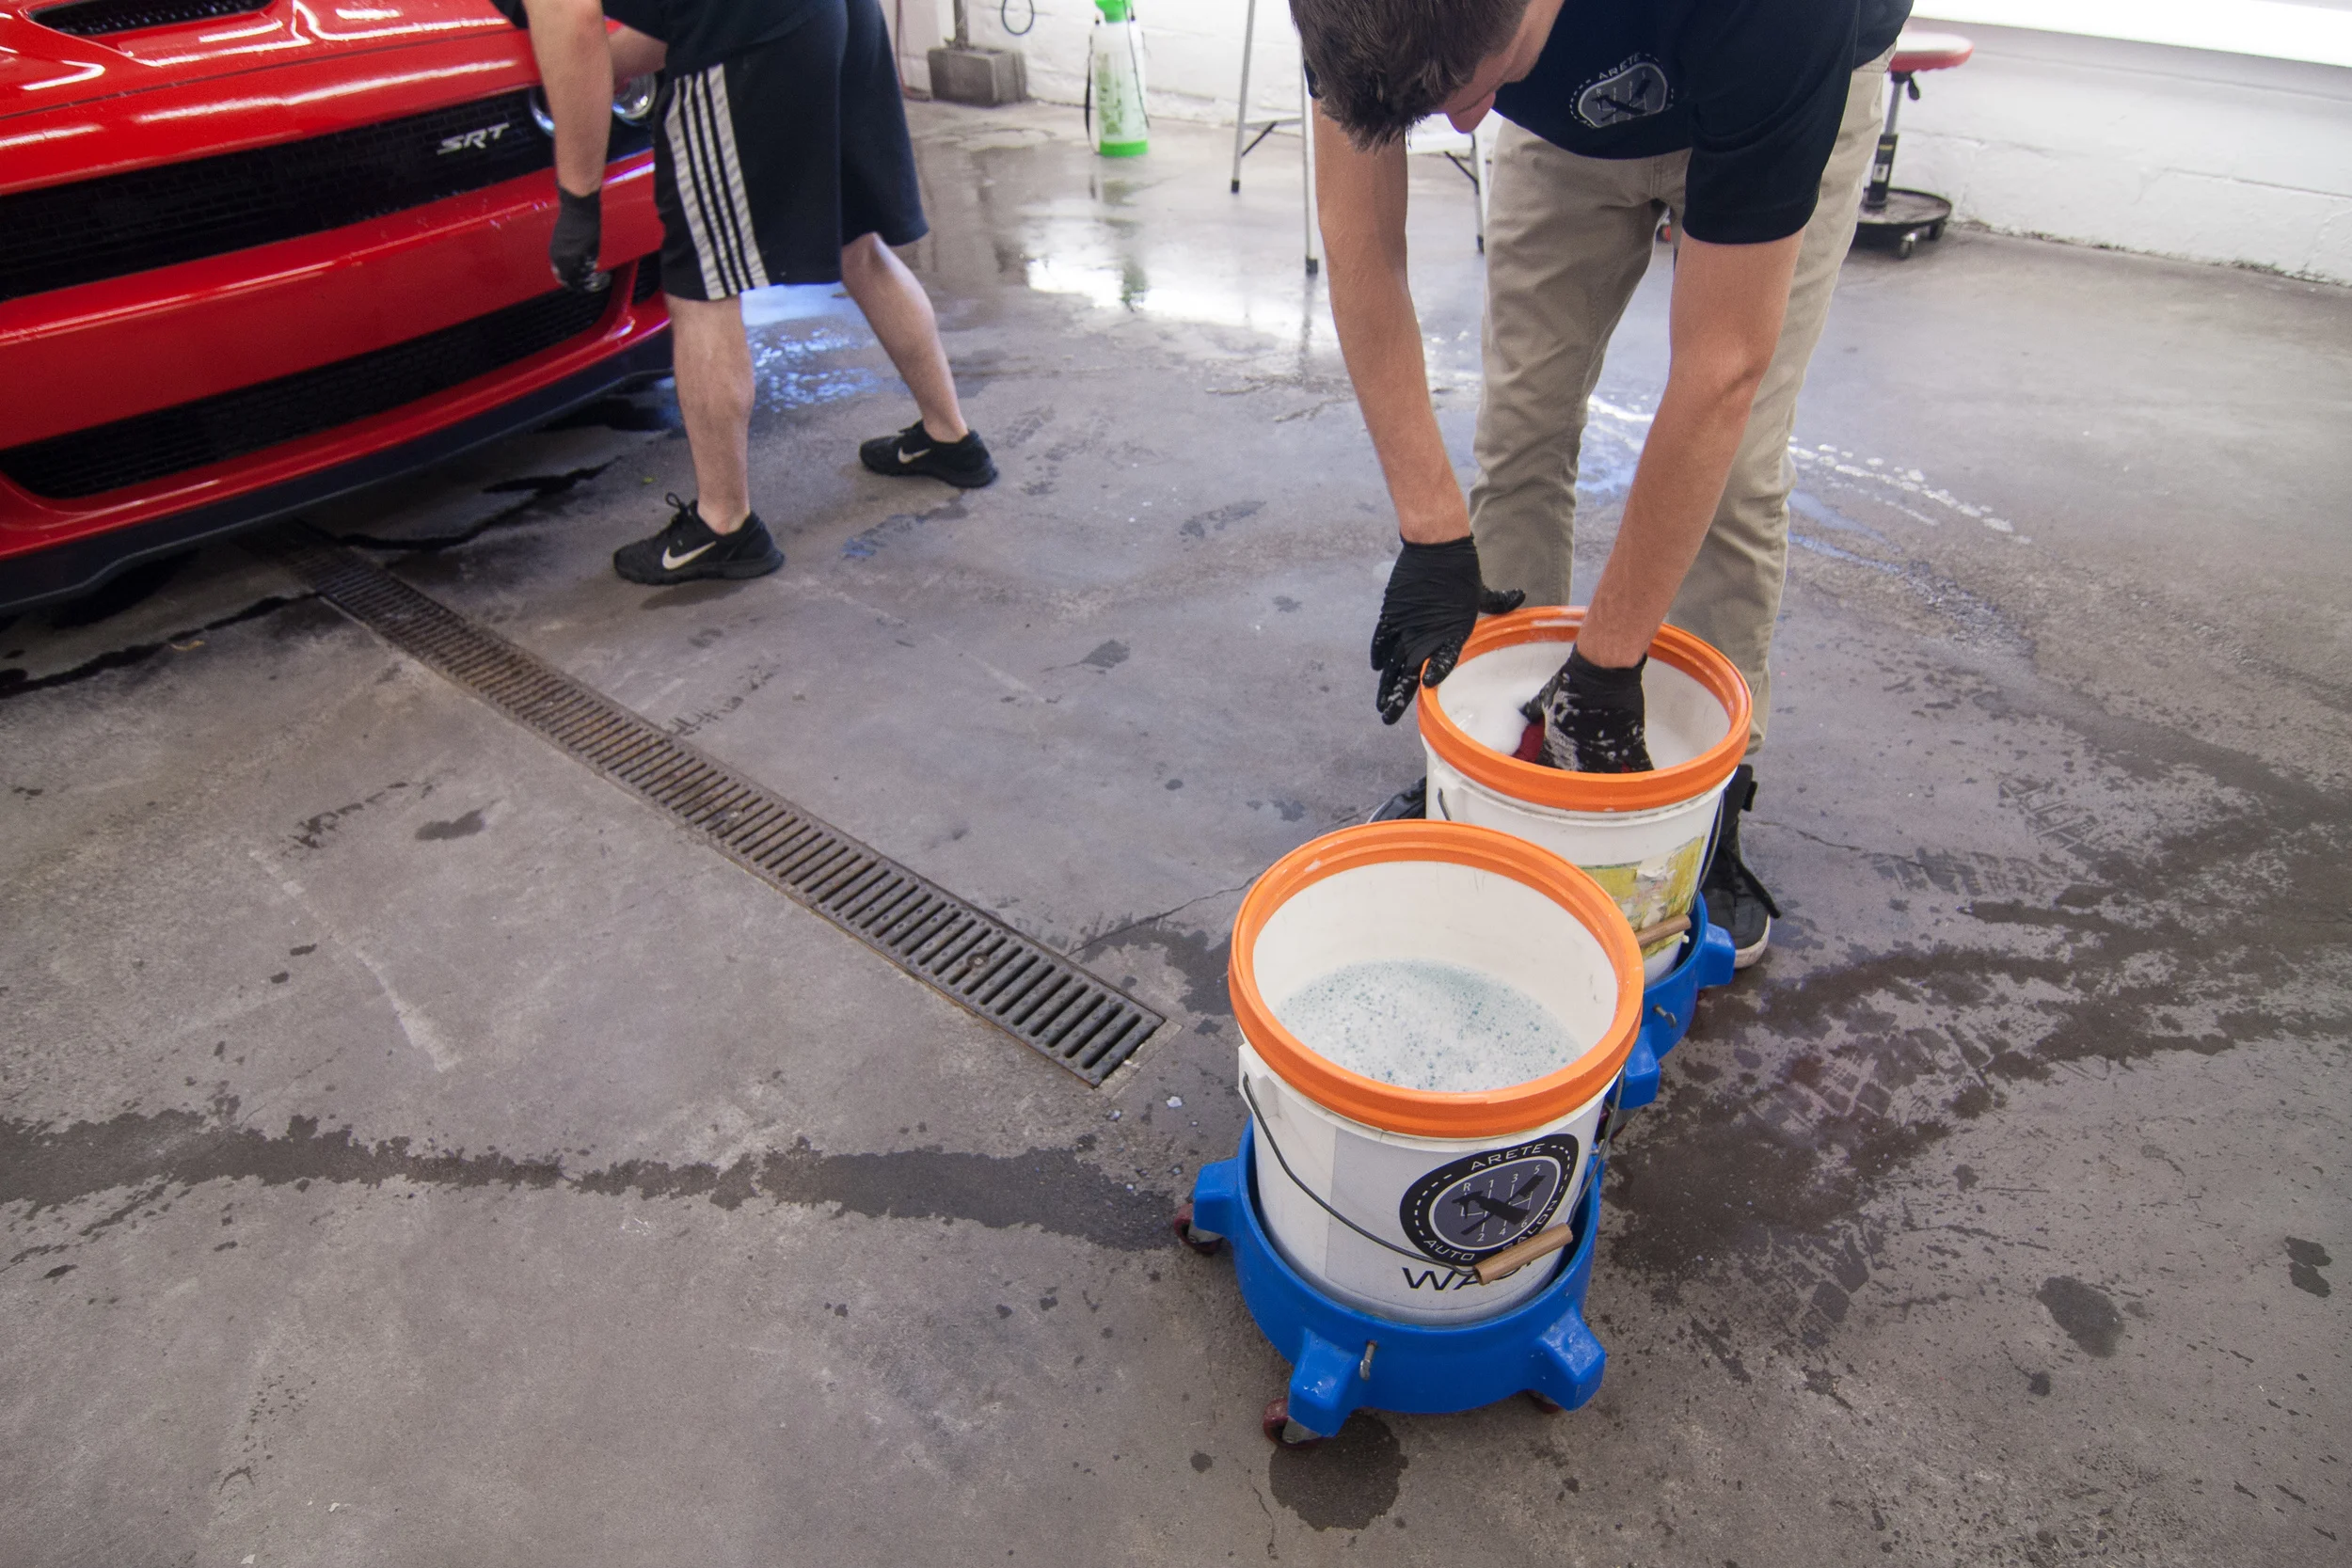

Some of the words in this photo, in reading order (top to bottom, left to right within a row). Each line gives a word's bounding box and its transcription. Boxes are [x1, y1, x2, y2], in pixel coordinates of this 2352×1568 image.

[1598, 52, 1641, 80] ARETE
[437, 122, 510, 155] SRT
[1470, 1143, 1545, 1171] ARETE
[1462, 1182, 1470, 1192] R
[1488, 1180, 1495, 1188] 1
[1511, 1173, 1518, 1183] 3
[1534, 1164, 1541, 1175] 5
[1476, 1232, 1485, 1243] 2
[1499, 1227, 1506, 1236] 4
[1520, 1218, 1528, 1228] 6
[1423, 1240, 1475, 1260] AUTO
